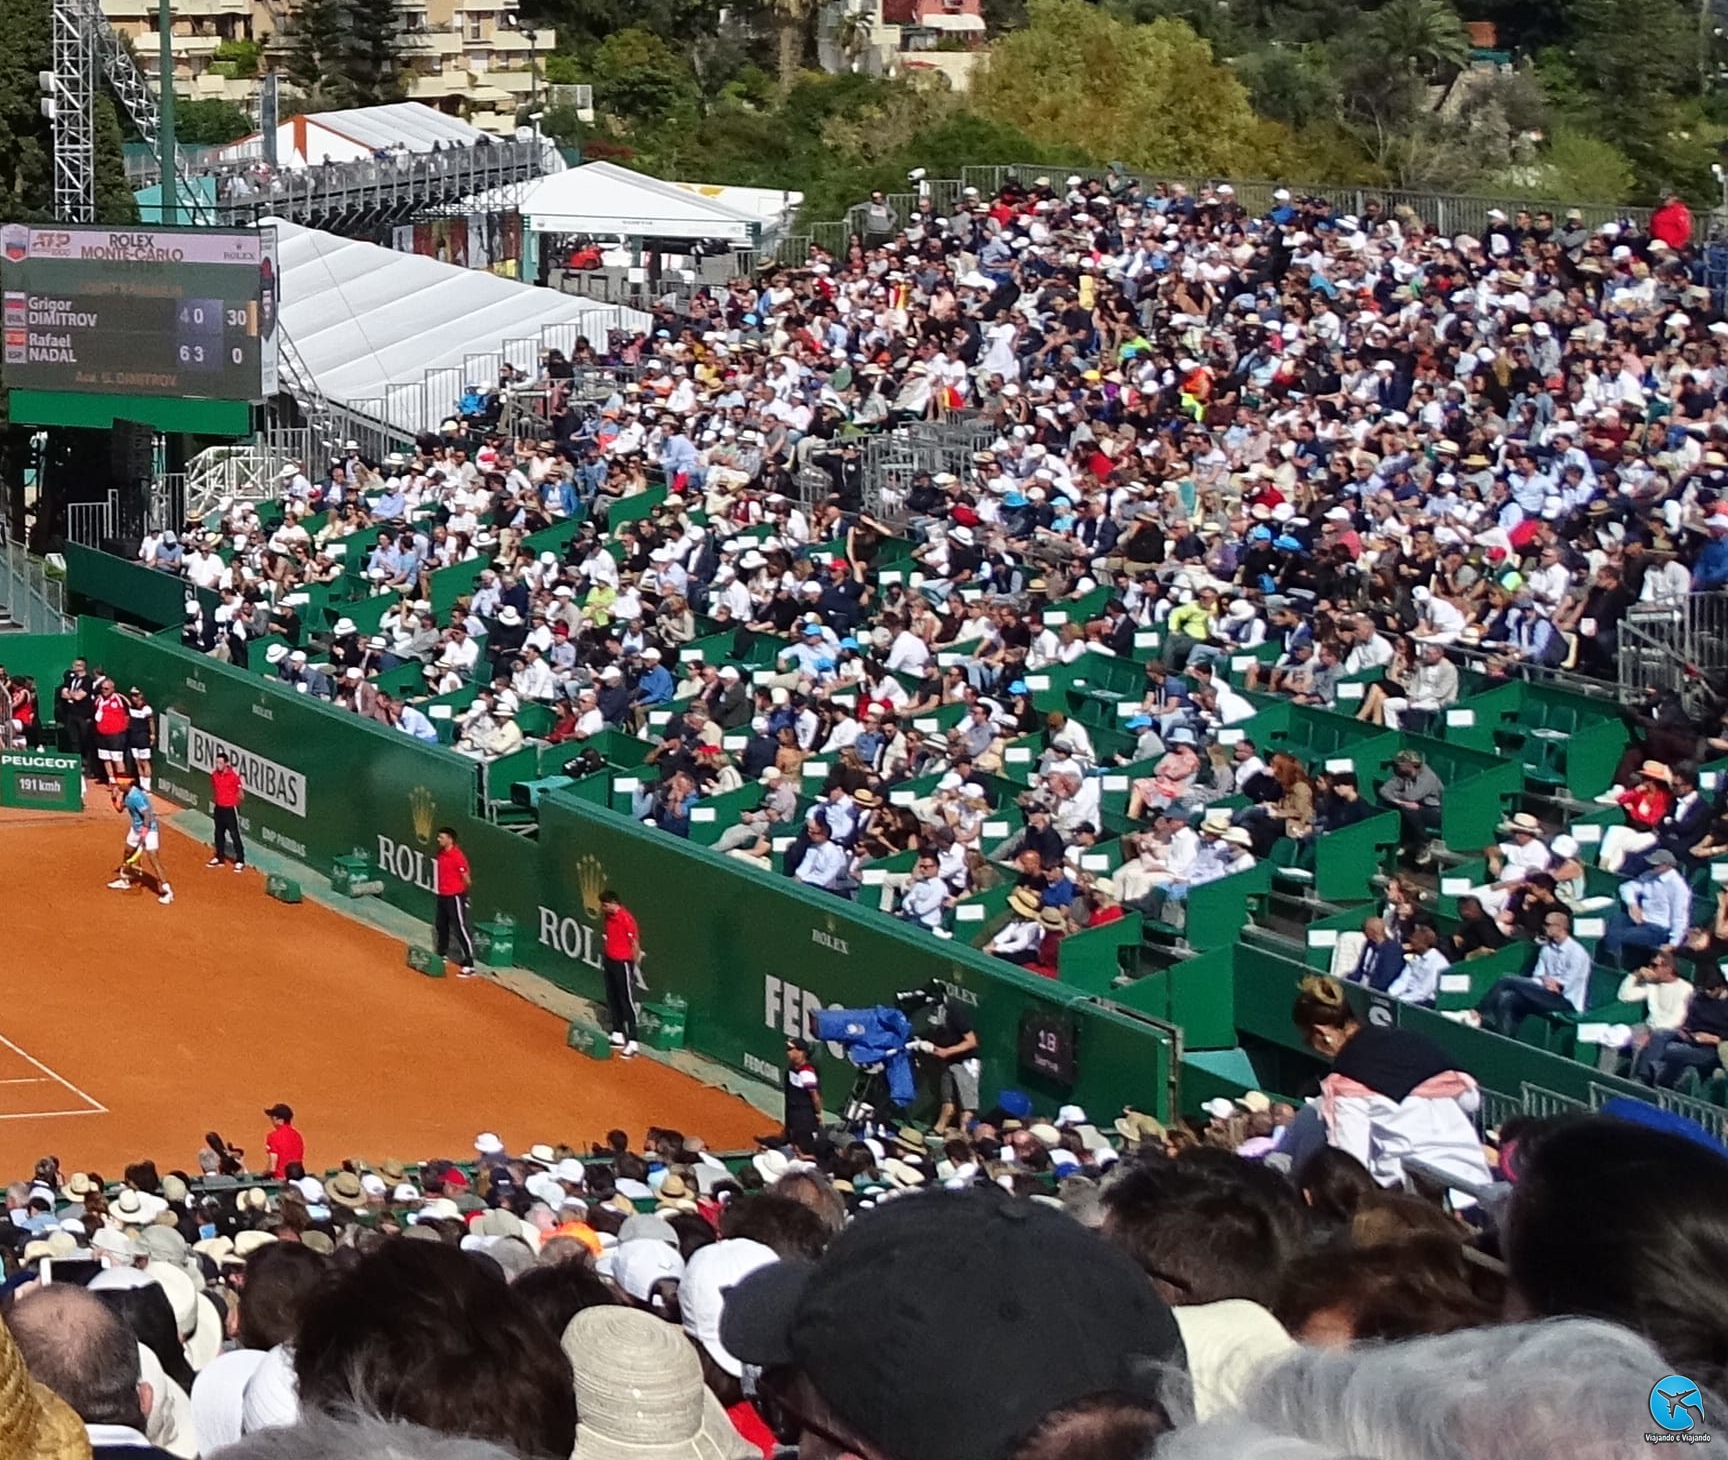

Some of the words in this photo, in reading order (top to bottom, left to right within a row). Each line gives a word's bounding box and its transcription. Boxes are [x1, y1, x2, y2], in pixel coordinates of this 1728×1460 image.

[32, 232, 71, 248] ATP
[109, 234, 154, 247] ROLEX
[81, 246, 184, 261] MONTE-CARLO
[224, 251, 255, 260] ROLEX
[29, 296, 72, 313] Grigor
[29, 310, 98, 327] DIMITROV
[194, 309, 204, 323] 0
[227, 308, 247, 326] 30
[29, 333, 72, 347] Rafael
[29, 348, 77, 363] NADAL
[180, 345, 190, 361] 6
[194, 346, 204, 362] 3
[232, 348, 243, 364] 0
[1, 755, 78, 769] PEUGEOT
[19, 778, 37, 790] 191
[39, 779, 60, 792] kmh
[812, 929, 849, 955] ROLEX
[946, 982, 979, 1007] OLEX
